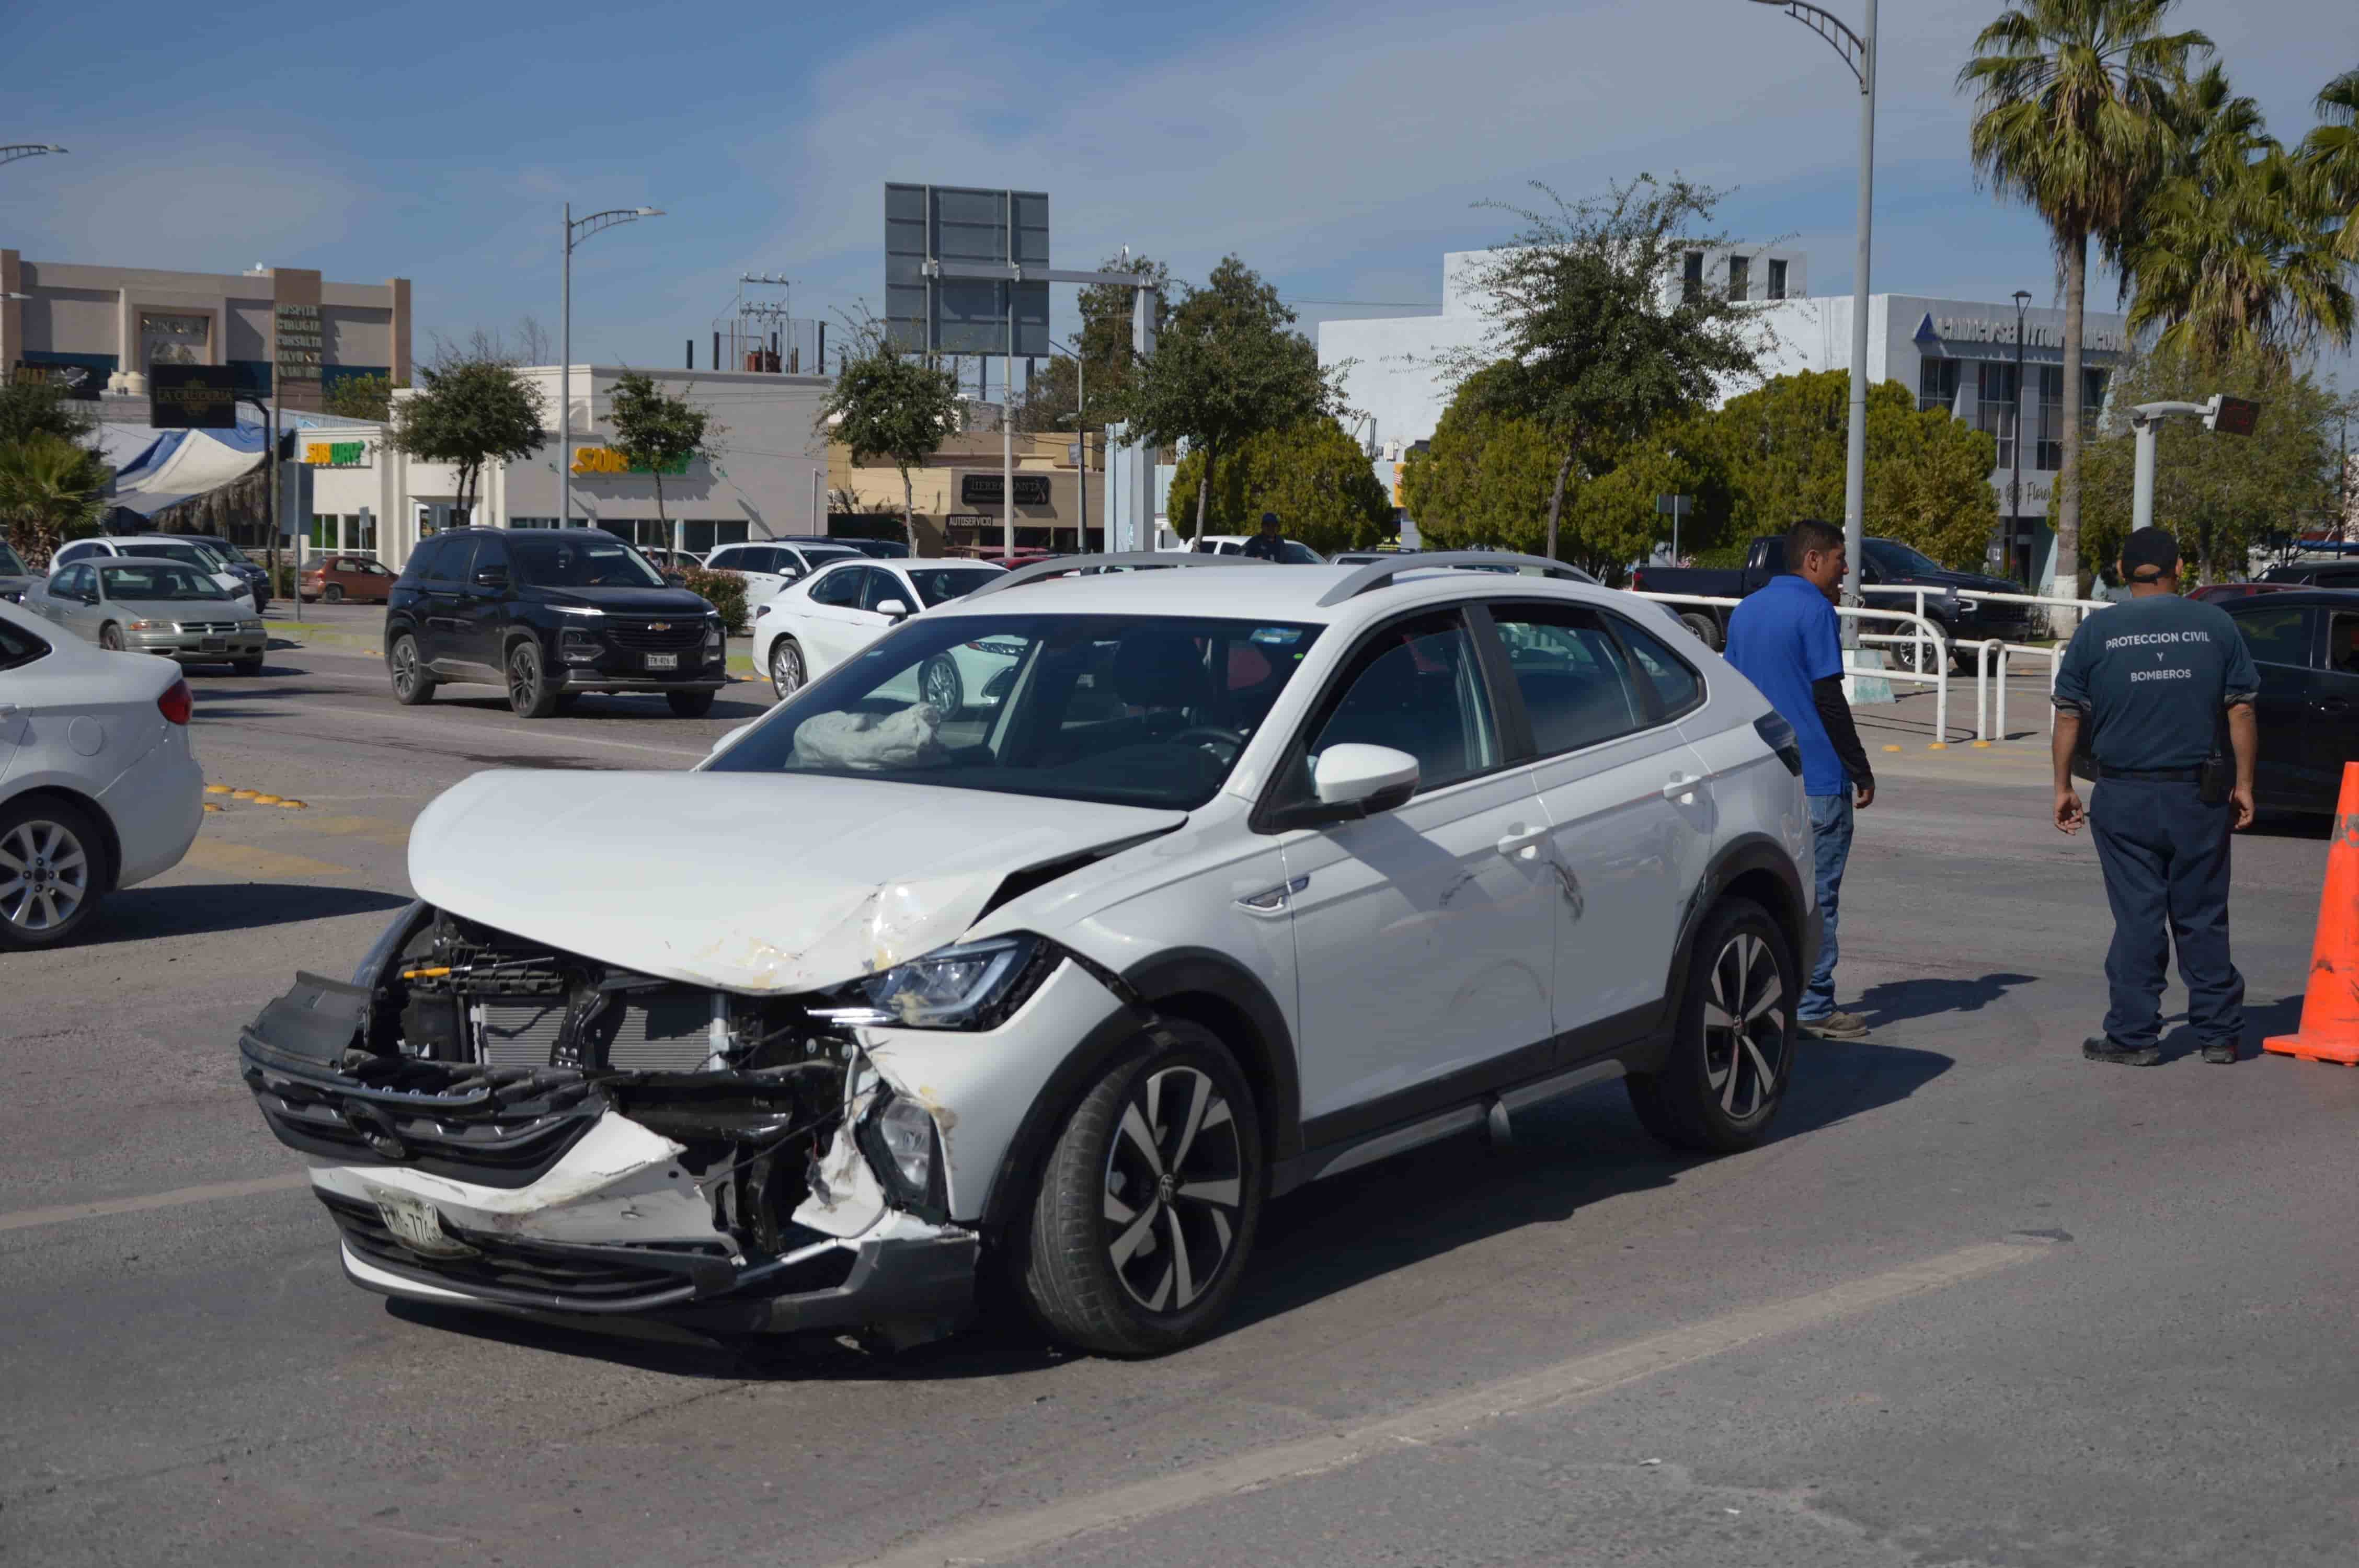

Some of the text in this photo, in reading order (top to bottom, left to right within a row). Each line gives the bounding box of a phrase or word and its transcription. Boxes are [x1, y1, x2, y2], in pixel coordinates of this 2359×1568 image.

[305, 440, 365, 463] SUBWAY
[1012, 480, 1040, 493] ANTA
[949, 516, 992, 526] AUTOSERVICIO
[2105, 631, 2211, 650] PROTECCION CIVIL
[2156, 652, 2164, 661] Y
[2131, 668, 2192, 682] BOMBEROS
